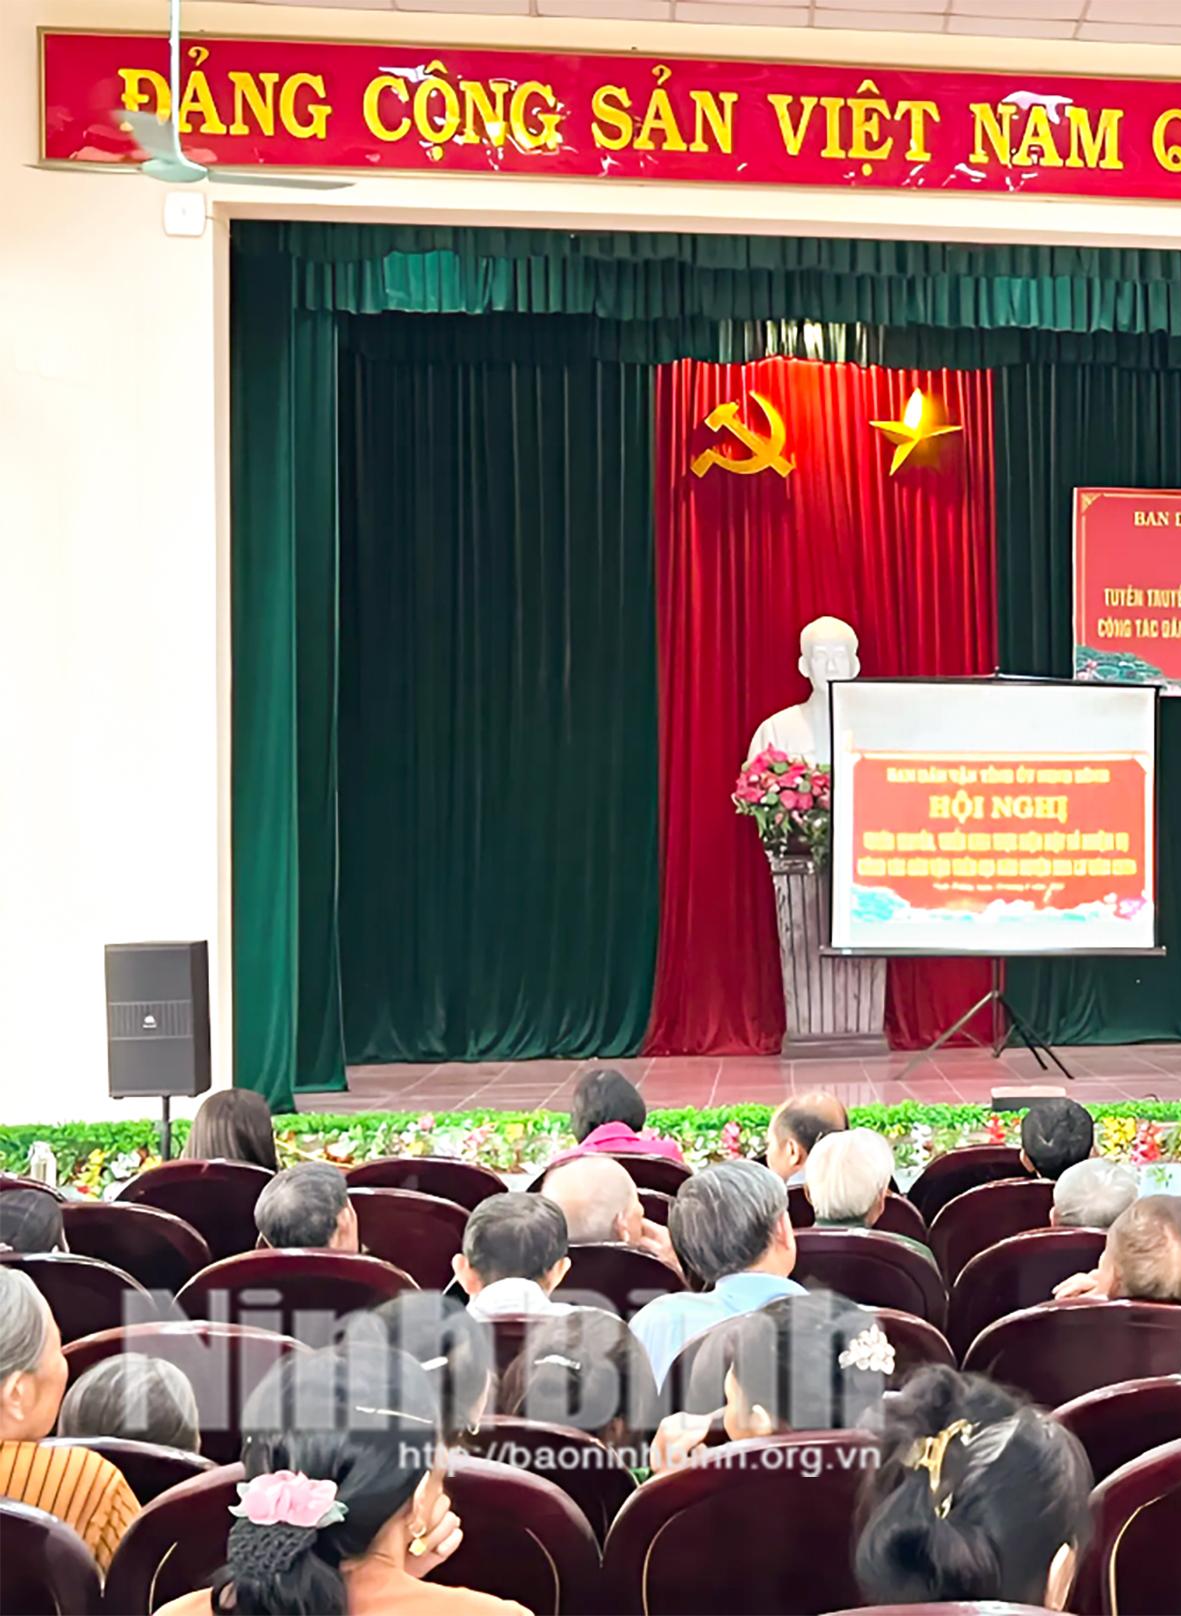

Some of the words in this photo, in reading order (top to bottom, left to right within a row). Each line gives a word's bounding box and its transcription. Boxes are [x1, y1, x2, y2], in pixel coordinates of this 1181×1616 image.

[118, 45, 332, 140] ĐẢNG
[362, 59, 563, 161] CỘNG
[590, 64, 739, 154] SẢN
[766, 78, 941, 177] VIỆT
[969, 102, 1124, 170] NAM
[1134, 511, 1169, 527] BAN
[928, 788, 985, 825] HỘI
[990, 795, 1069, 825] NGHỊ
